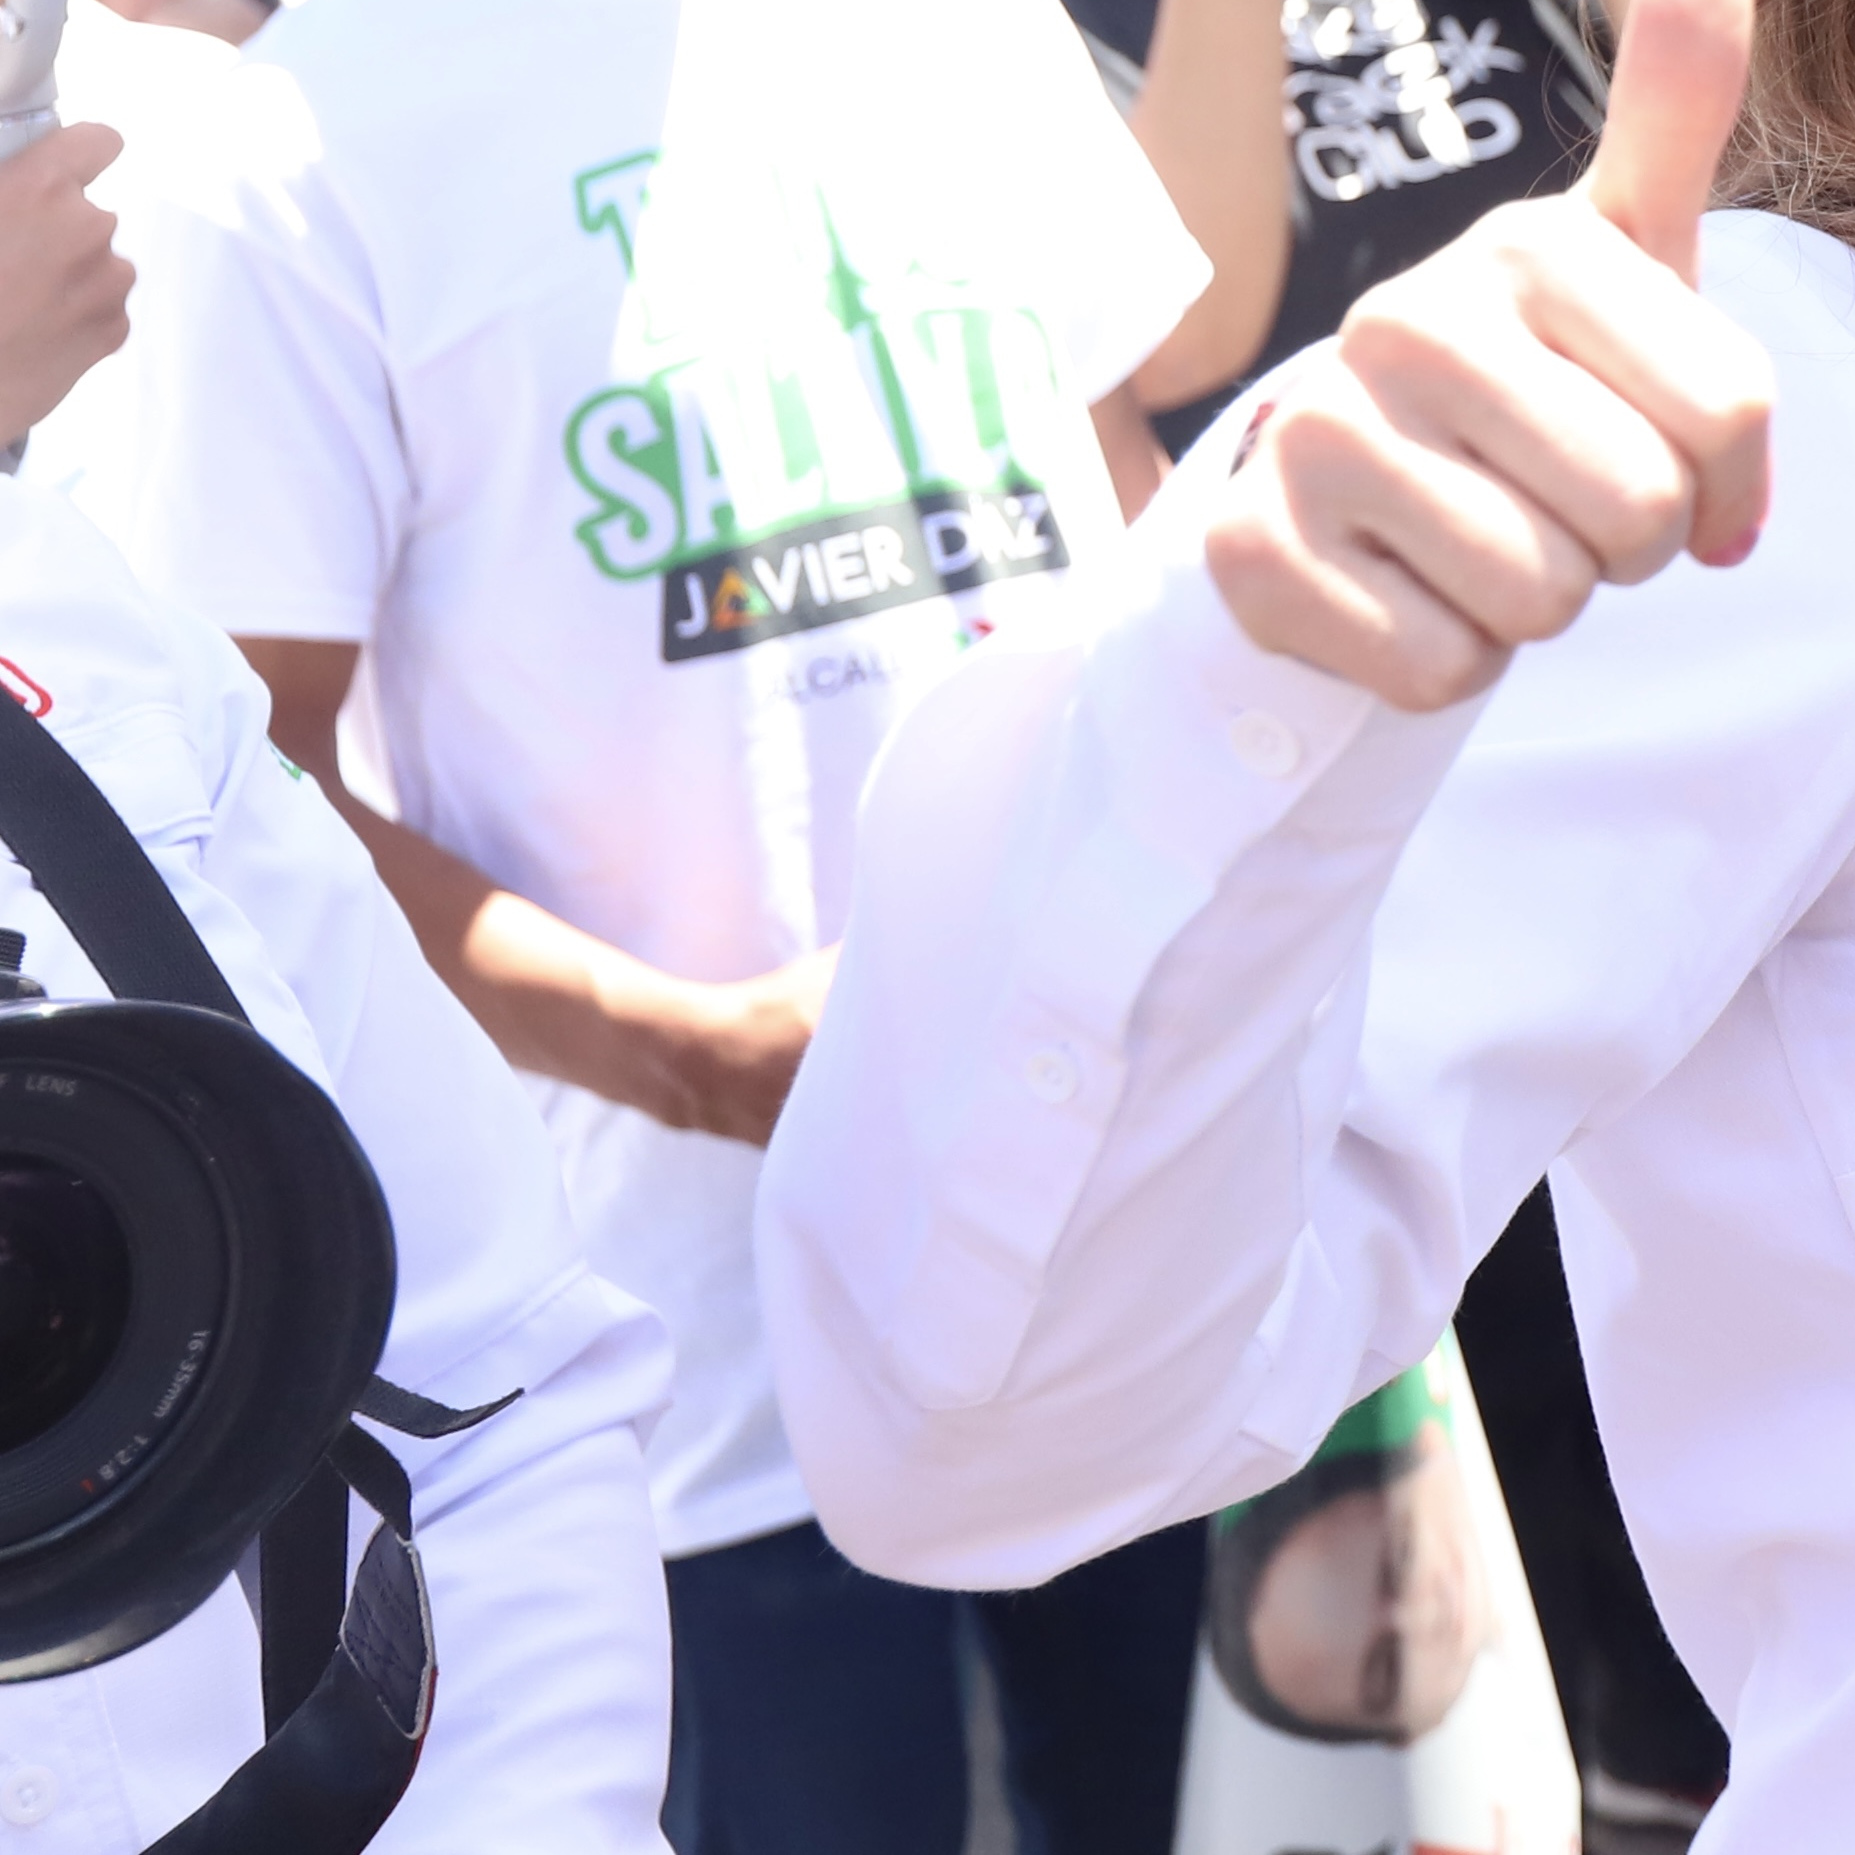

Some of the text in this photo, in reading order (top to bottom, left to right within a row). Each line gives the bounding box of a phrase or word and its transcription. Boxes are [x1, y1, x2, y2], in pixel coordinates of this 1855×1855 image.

[675, 523, 915, 640] JAVIER
[25, 1073, 78, 1096] LENS
[152, 1329, 210, 1418] 16-35mm
